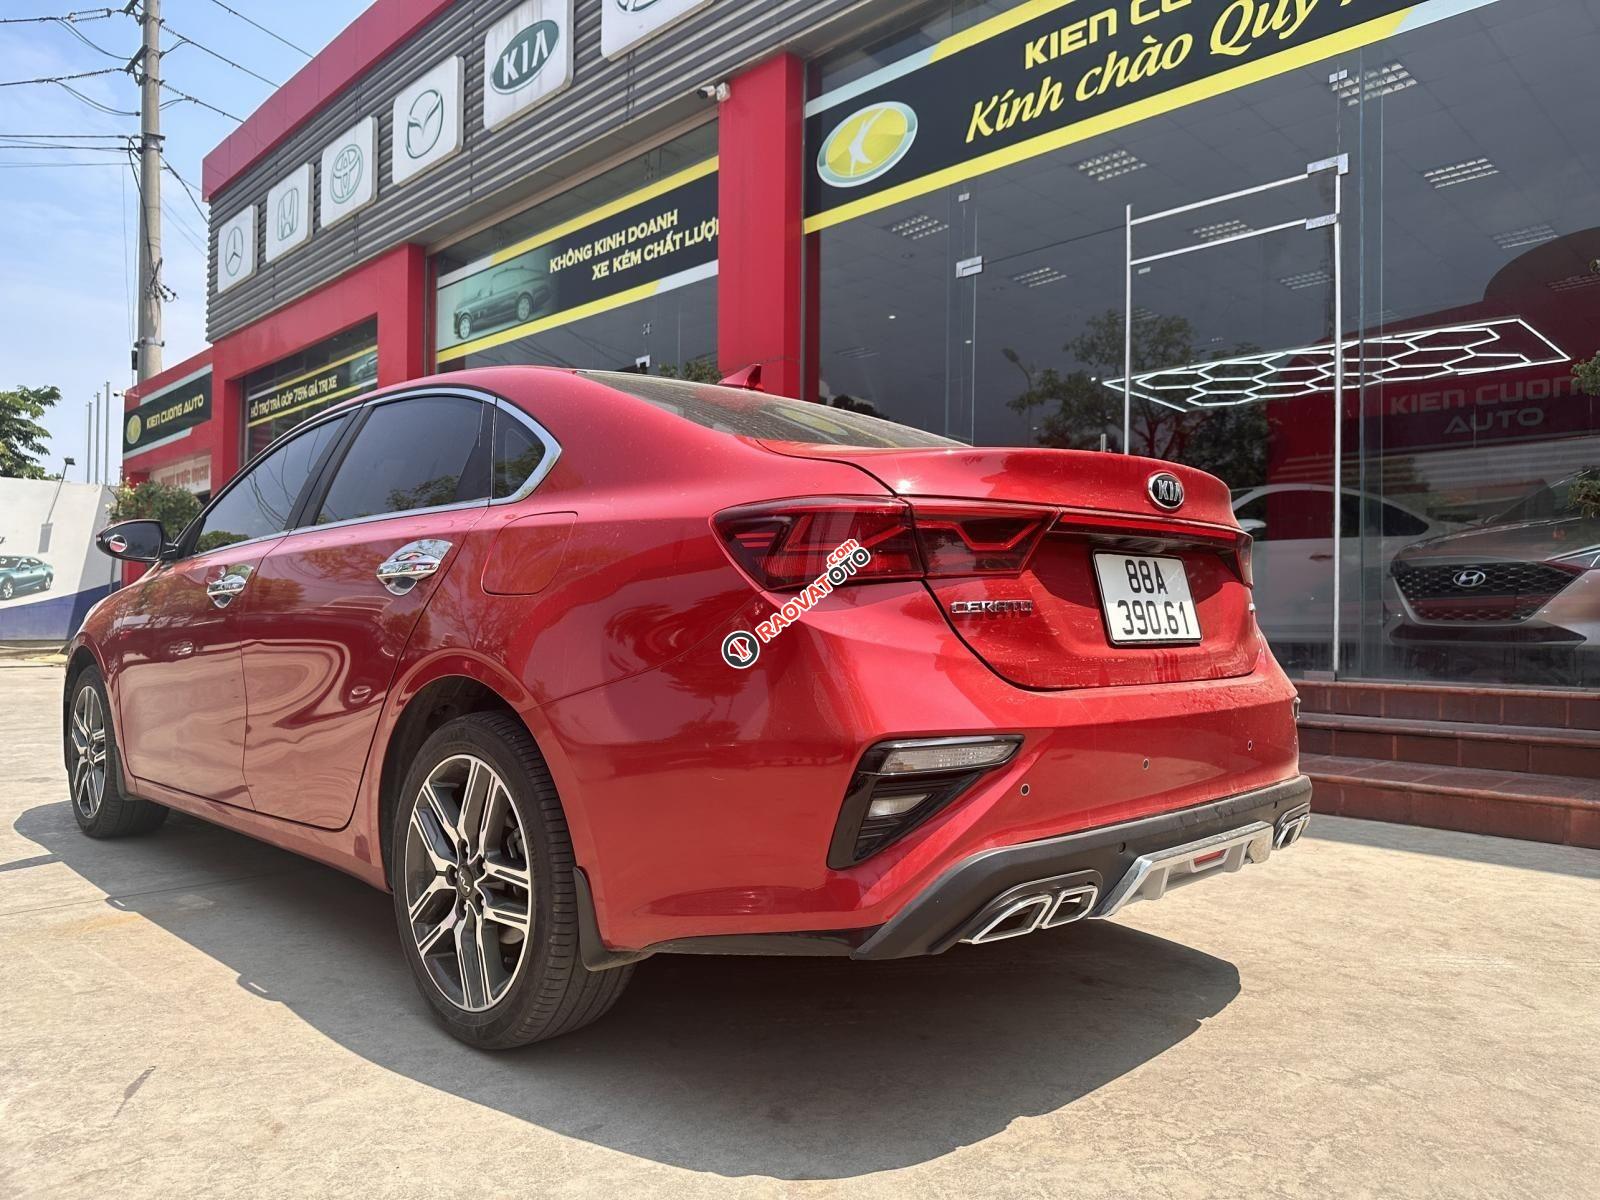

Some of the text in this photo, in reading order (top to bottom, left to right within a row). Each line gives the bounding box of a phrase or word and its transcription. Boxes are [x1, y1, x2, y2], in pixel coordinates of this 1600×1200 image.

[501, 29, 549, 86] KIA
[1025, 8, 1117, 70] KIEN
[965, 76, 1064, 144] Kính
[1075, 33, 1193, 102] chào
[550, 209, 679, 274] KHÔNG KINH DOANH
[592, 260, 610, 281] XE
[612, 249, 642, 273] KÉM
[643, 230, 684, 262] CHẤT
[293, 384, 308, 402] 75%
[328, 374, 338, 391] XE
[1390, 375, 1580, 416] KIEN CUON
[146, 393, 204, 430] KIEN CUONG AUTO
[1444, 407, 1545, 434] AUTO
[1157, 479, 1182, 502] KIA
[1125, 559, 1168, 594] 88A
[1117, 600, 1190, 635] 390.61
